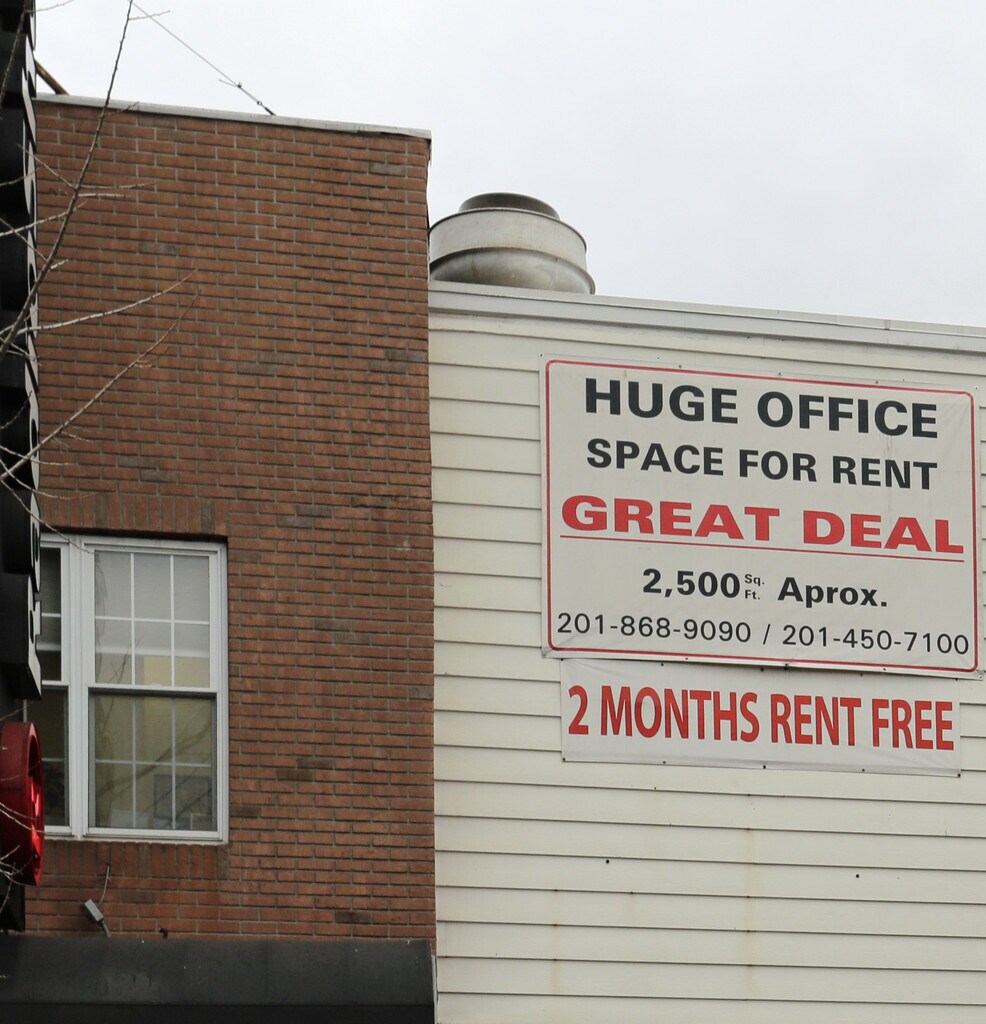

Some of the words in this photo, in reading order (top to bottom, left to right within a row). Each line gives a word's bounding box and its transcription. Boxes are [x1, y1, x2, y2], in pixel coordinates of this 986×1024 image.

[585, 378, 738, 424] HUGE
[757, 391, 938, 439] OFFICE
[586, 438, 724, 476] SPACE
[738, 449, 817, 482] FOR
[832, 456, 938, 490] RENT
[561, 495, 780, 541] GREAT
[803, 510, 964, 554] DEAL
[643, 568, 741, 600] 2,500
[744, 573, 765, 587] Sq.
[777, 576, 888, 608] Aprox.
[744, 589, 761, 600] Ft.
[557, 612, 751, 644] 201-868-9090
[763, 624, 771, 645] /
[782, 624, 969, 655] 201-450-7100
[568, 685, 589, 735] 2
[600, 685, 760, 743] MONTHS
[770, 693, 862, 746] RENT
[872, 699, 954, 751] FREE
